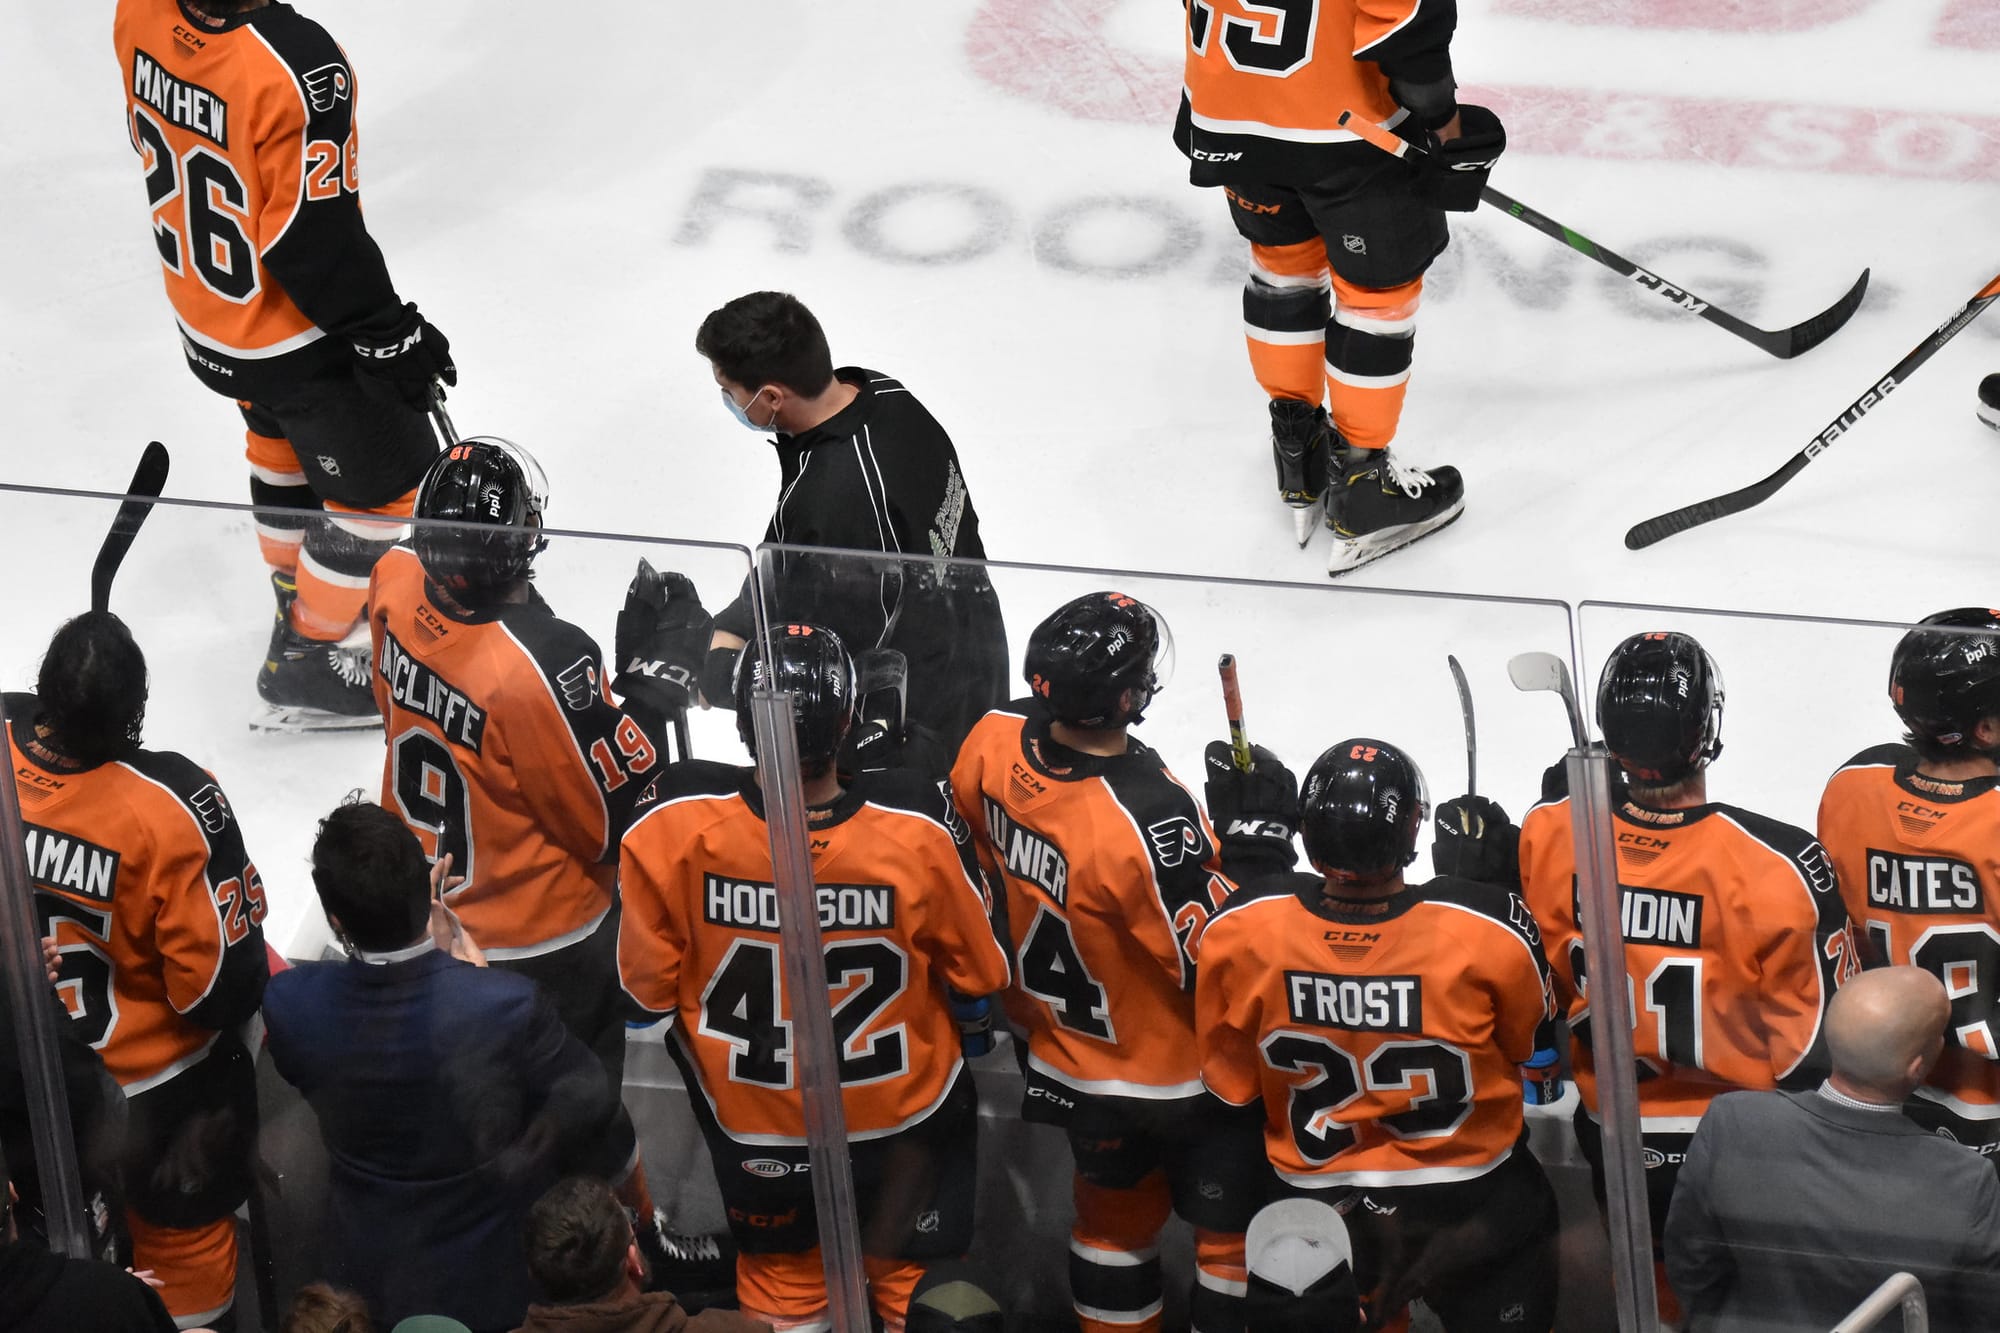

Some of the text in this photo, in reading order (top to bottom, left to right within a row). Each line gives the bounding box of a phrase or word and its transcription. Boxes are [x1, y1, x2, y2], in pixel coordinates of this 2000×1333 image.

[172, 25, 206, 49] CCM
[134, 54, 225, 144] MAYHEW
[304, 133, 359, 201] 26
[1192, 150, 1244, 163] CCM
[133, 102, 262, 305] 26
[1627, 267, 1709, 315] CCM
[354, 325, 422, 360] CCM
[199, 357, 234, 378] CCM
[1803, 375, 1900, 462] BAUER
[489, 493, 501, 518] ppl
[416, 604, 449, 637] CCM
[1106, 633, 1126, 657] ppl
[1964, 644, 1988, 665] ppl
[1677, 673, 1690, 698] ppl
[589, 713, 657, 793] 19
[17, 767, 65, 791] CCM
[1011, 762, 1048, 795] CCM
[1385, 799, 1399, 824] ppl
[1897, 801, 1948, 820] CCM
[1617, 832, 1672, 850] CCM
[1870, 855, 1977, 909] CATES
[215, 860, 269, 948] 25
[708, 878, 889, 928] HODSON
[1323, 930, 1382, 943] CCM
[697, 936, 910, 1091] 42
[1290, 975, 1415, 1028] FROST
[1026, 1086, 1075, 1109] CCM
[1258, 1029, 1475, 1166] 23
